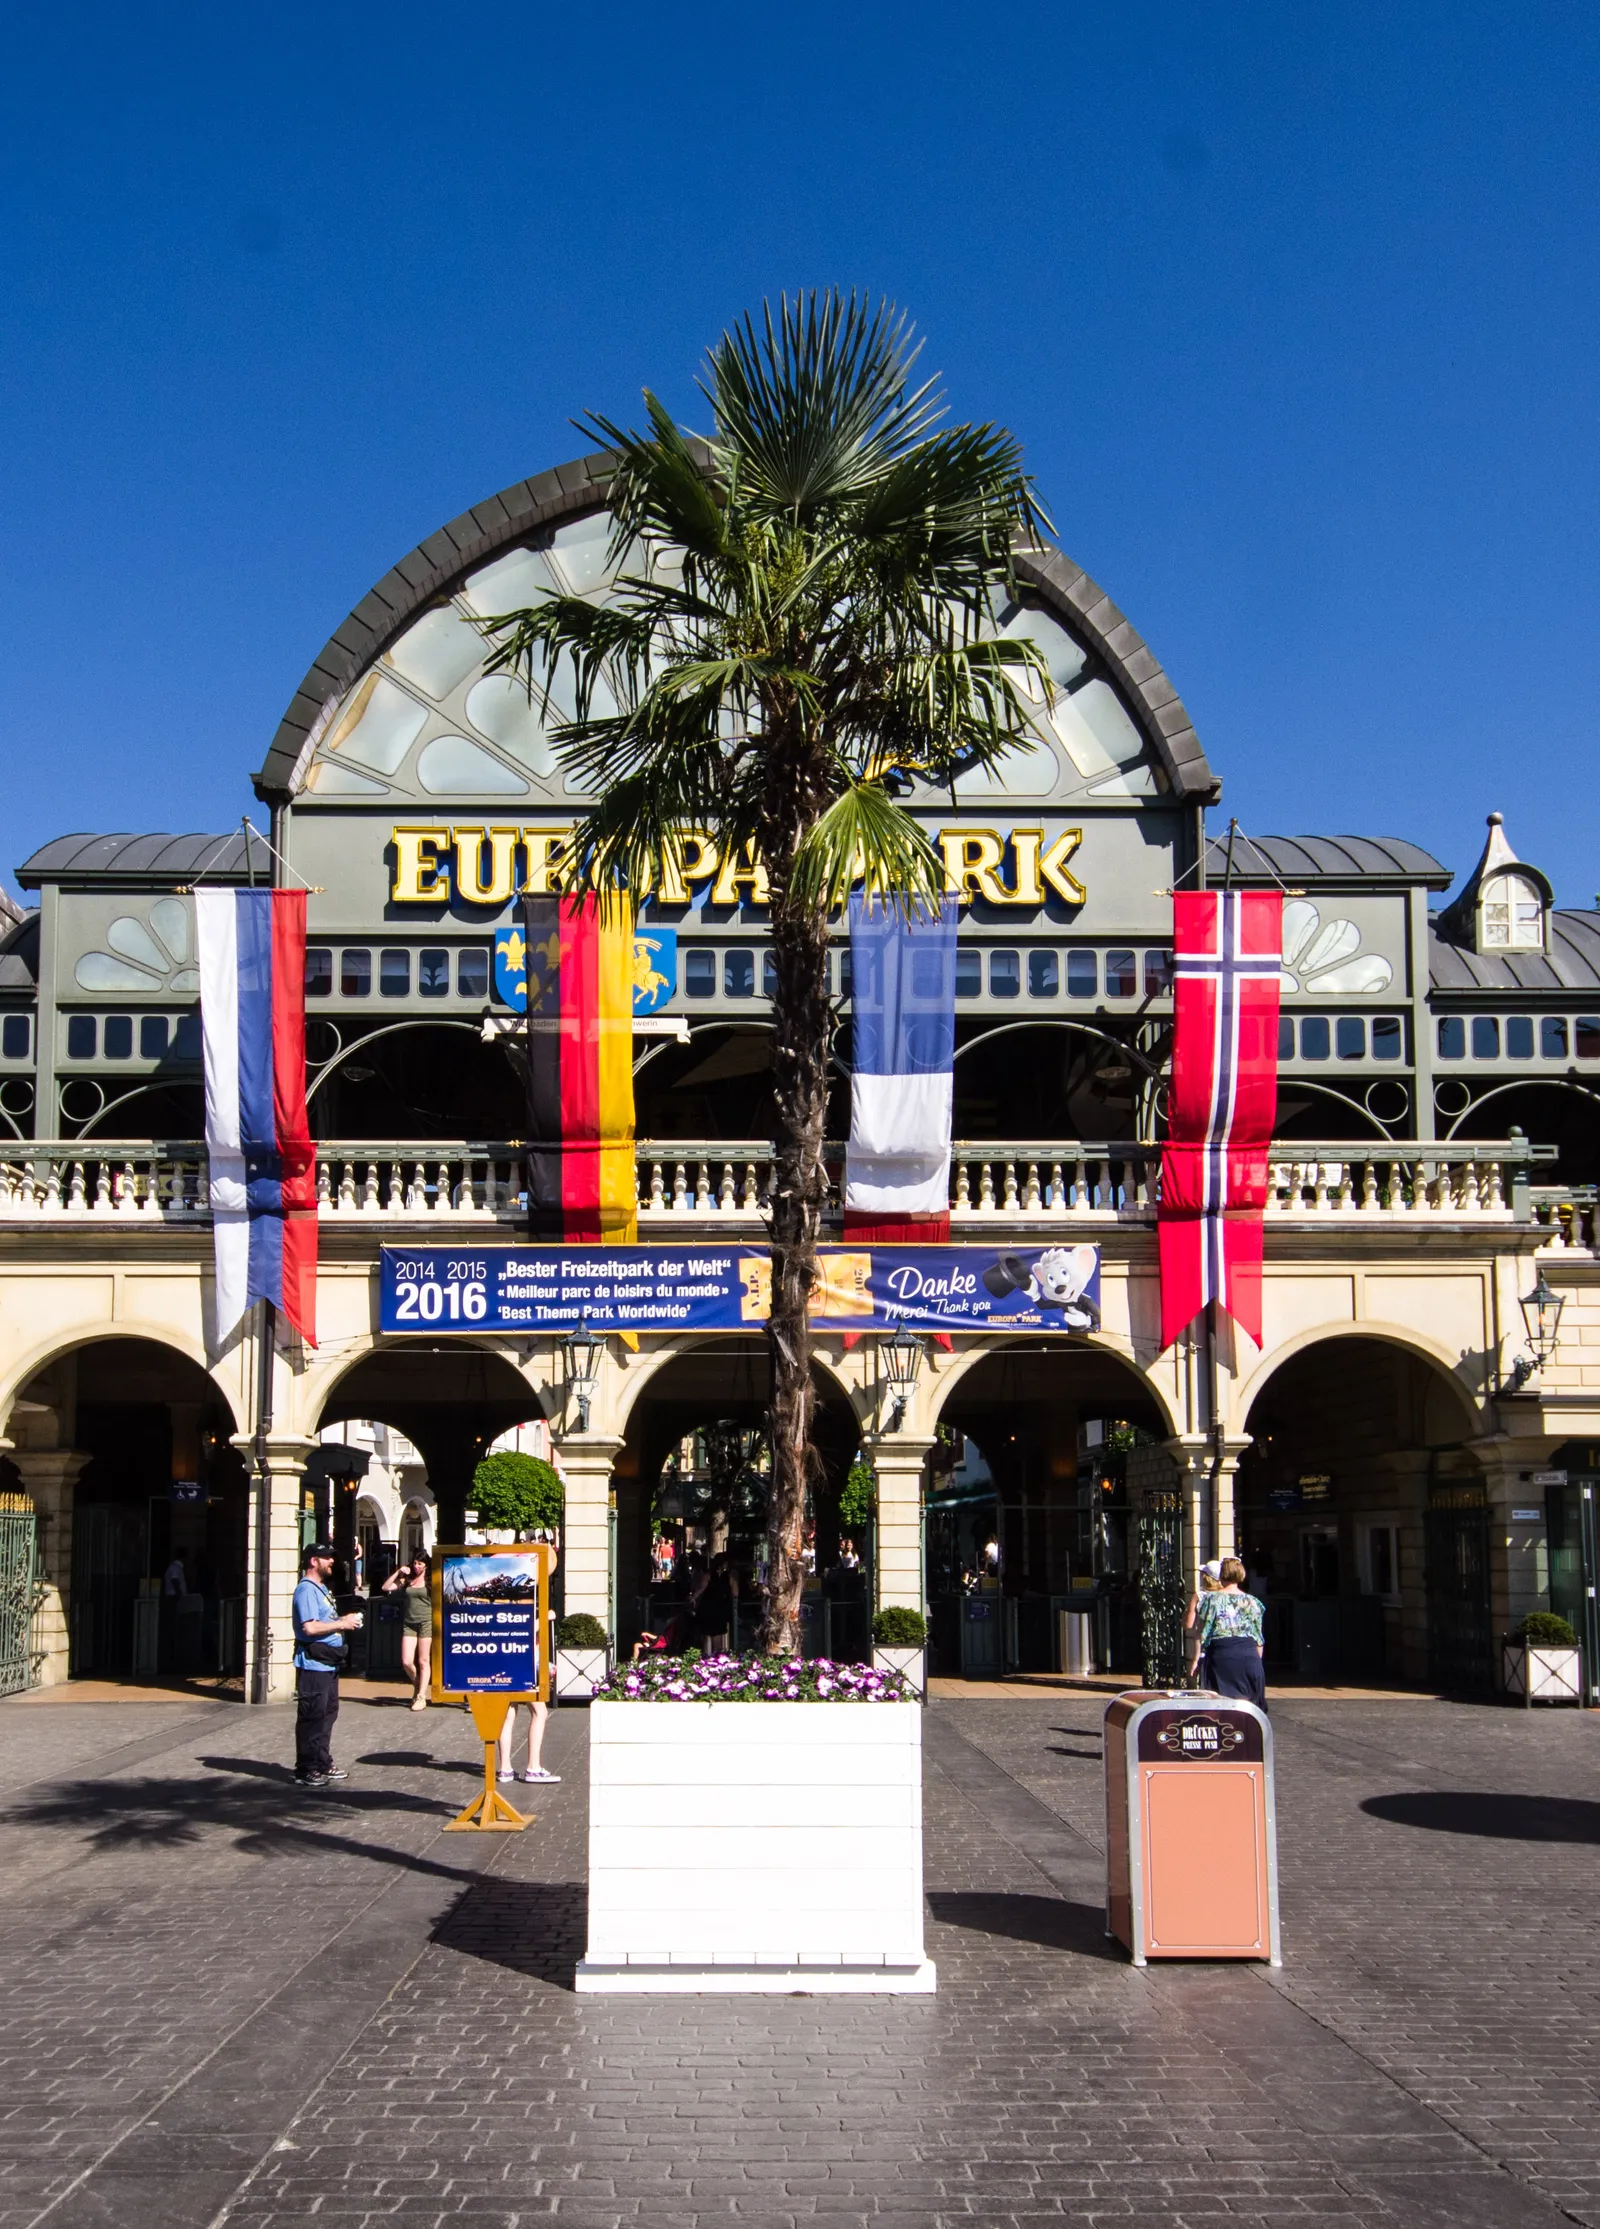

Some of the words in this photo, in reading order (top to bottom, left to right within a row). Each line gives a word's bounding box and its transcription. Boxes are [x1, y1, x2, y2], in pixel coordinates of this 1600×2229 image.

[392, 826, 770, 905] EURPA
[511, 1019, 557, 1028] Wiebaden
[396, 1261, 435, 1279] 2014
[447, 1261, 487, 1279] 2015
[561, 1260, 654, 1280] Freizeitpark
[658, 1260, 684, 1277] der
[562, 1286, 591, 1300] parc
[594, 1285, 611, 1298] de
[614, 1284, 653, 1297] loisirs
[656, 1283, 673, 1297] du
[888, 1266, 977, 1299] Danke
[396, 1282, 487, 1320] 2016
[883, 1301, 929, 1321] Merci
[931, 1298, 969, 1314] Thank
[972, 1301, 991, 1315] you
[535, 1306, 580, 1319] Theme
[583, 1305, 614, 1318] Park
[450, 1613, 494, 1624] Silver
[496, 1612, 530, 1624] Star
[451, 1643, 498, 1654] 20.00
[501, 1643, 530, 1653] Uhr
